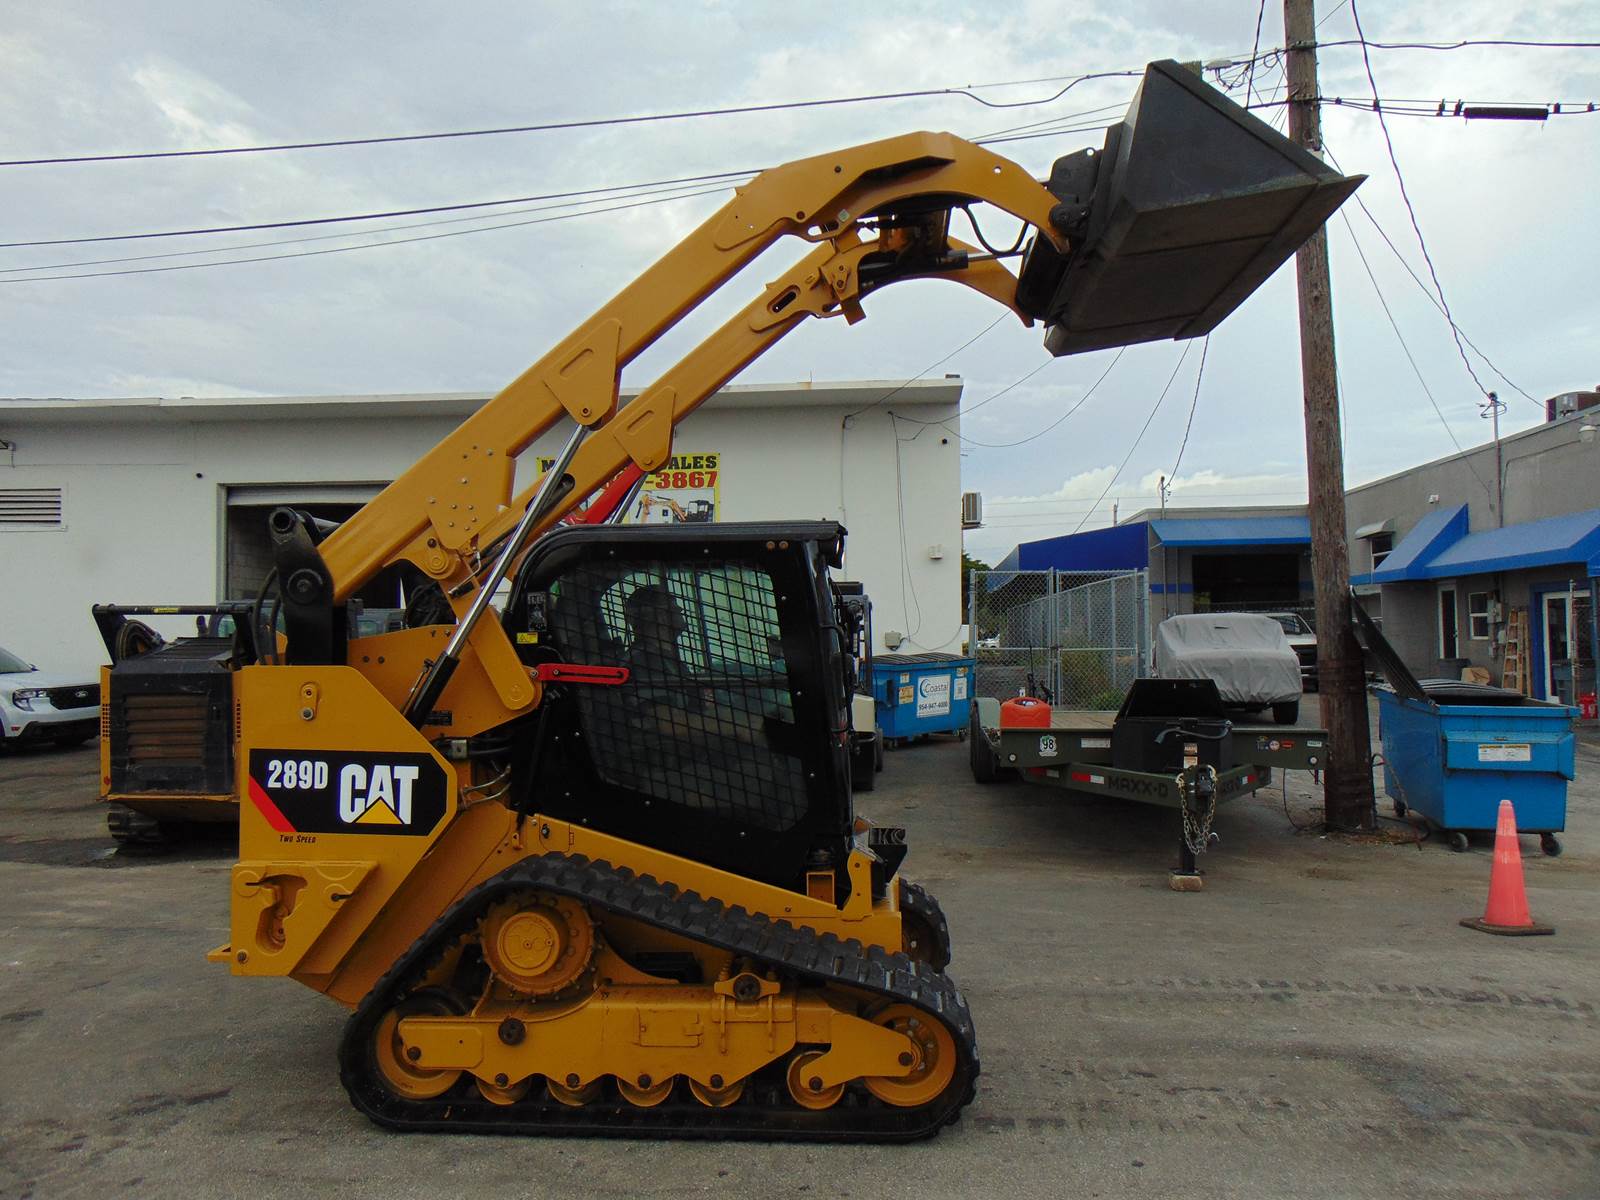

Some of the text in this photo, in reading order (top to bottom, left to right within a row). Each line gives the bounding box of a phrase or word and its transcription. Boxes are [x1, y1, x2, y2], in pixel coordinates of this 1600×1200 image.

[667, 455, 717, 469] ALES
[645, 471, 718, 489] -3867
[267, 759, 329, 790] 289D
[339, 763, 419, 825] CAT
